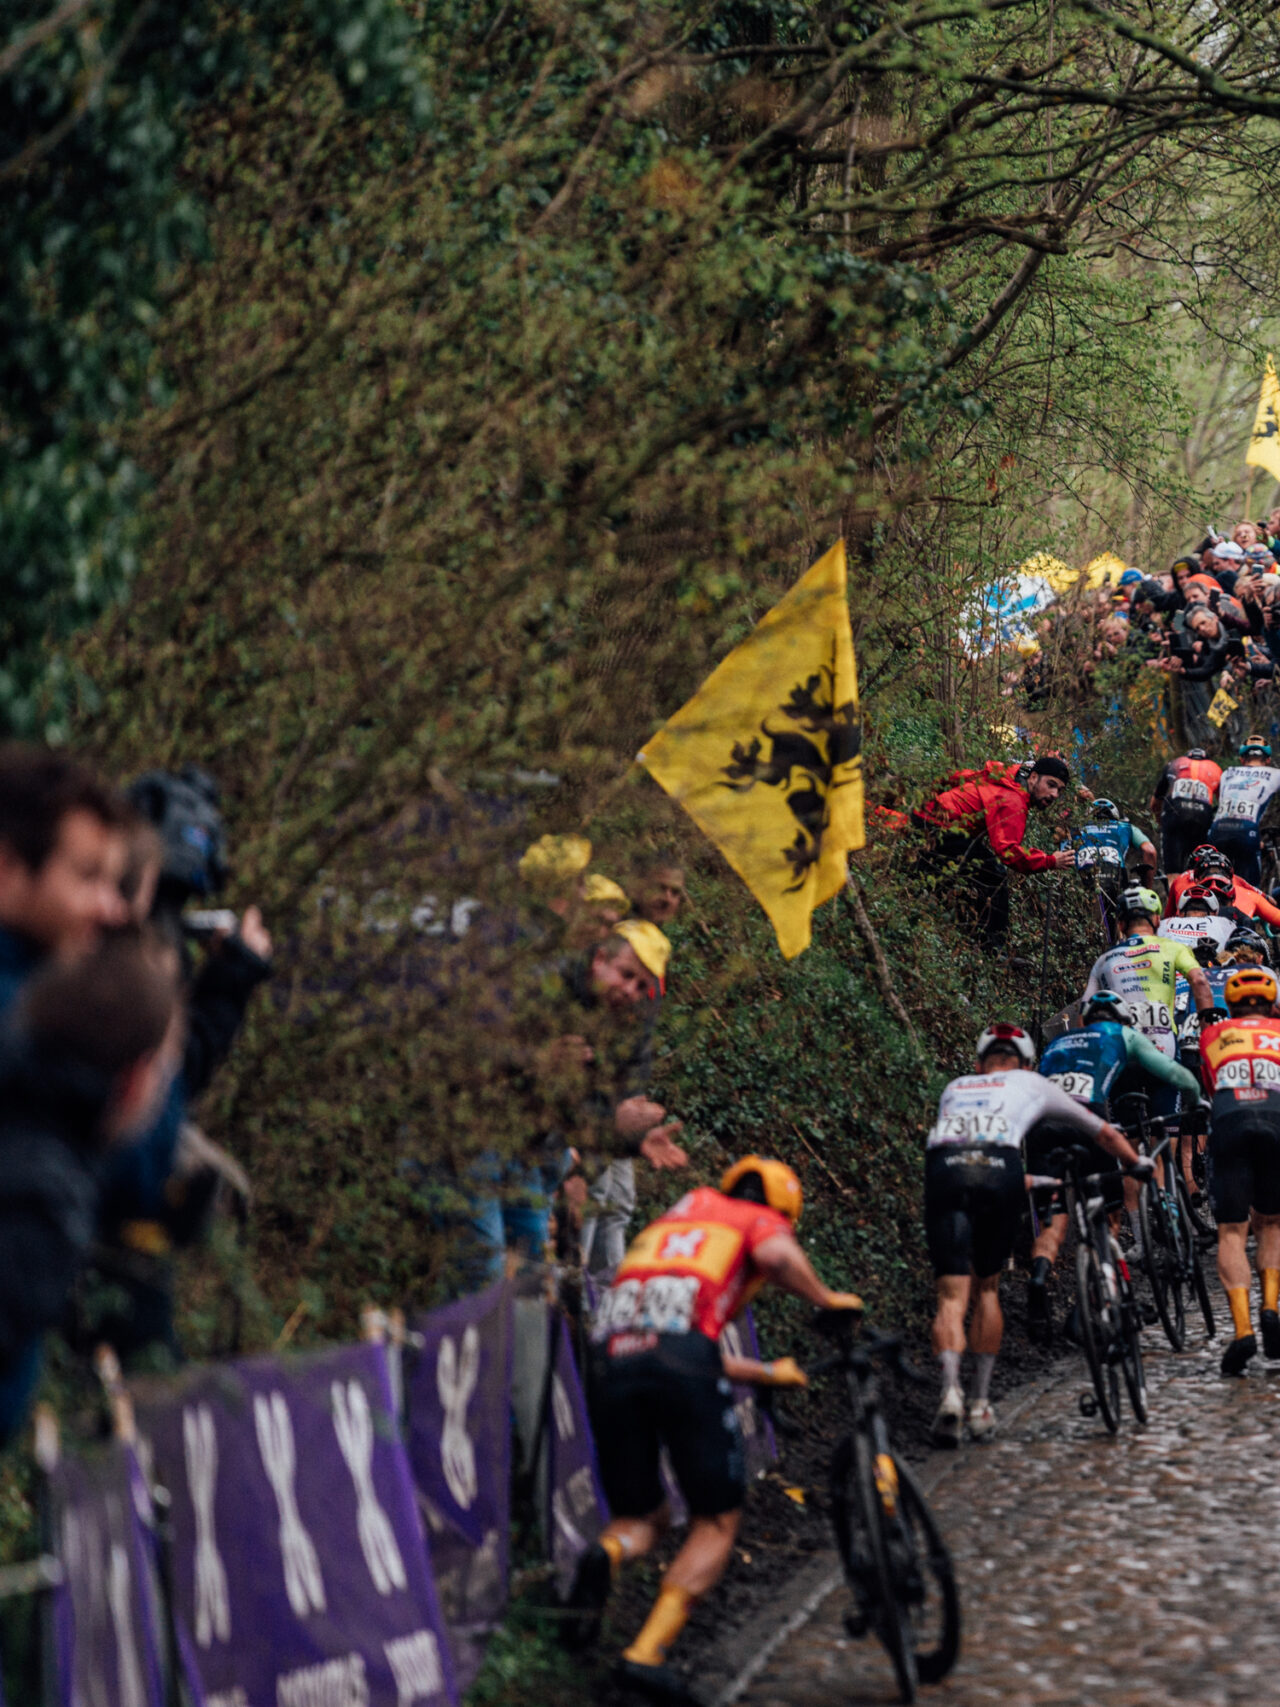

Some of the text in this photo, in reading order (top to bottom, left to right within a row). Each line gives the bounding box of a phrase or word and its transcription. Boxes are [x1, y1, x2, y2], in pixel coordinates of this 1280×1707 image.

[1237, 801, 1254, 816] 61
[1170, 922, 1207, 931] UAE
[1146, 1004, 1170, 1026] 16
[1063, 1075, 1091, 1094] 97
[973, 1114, 1009, 1134] 173
